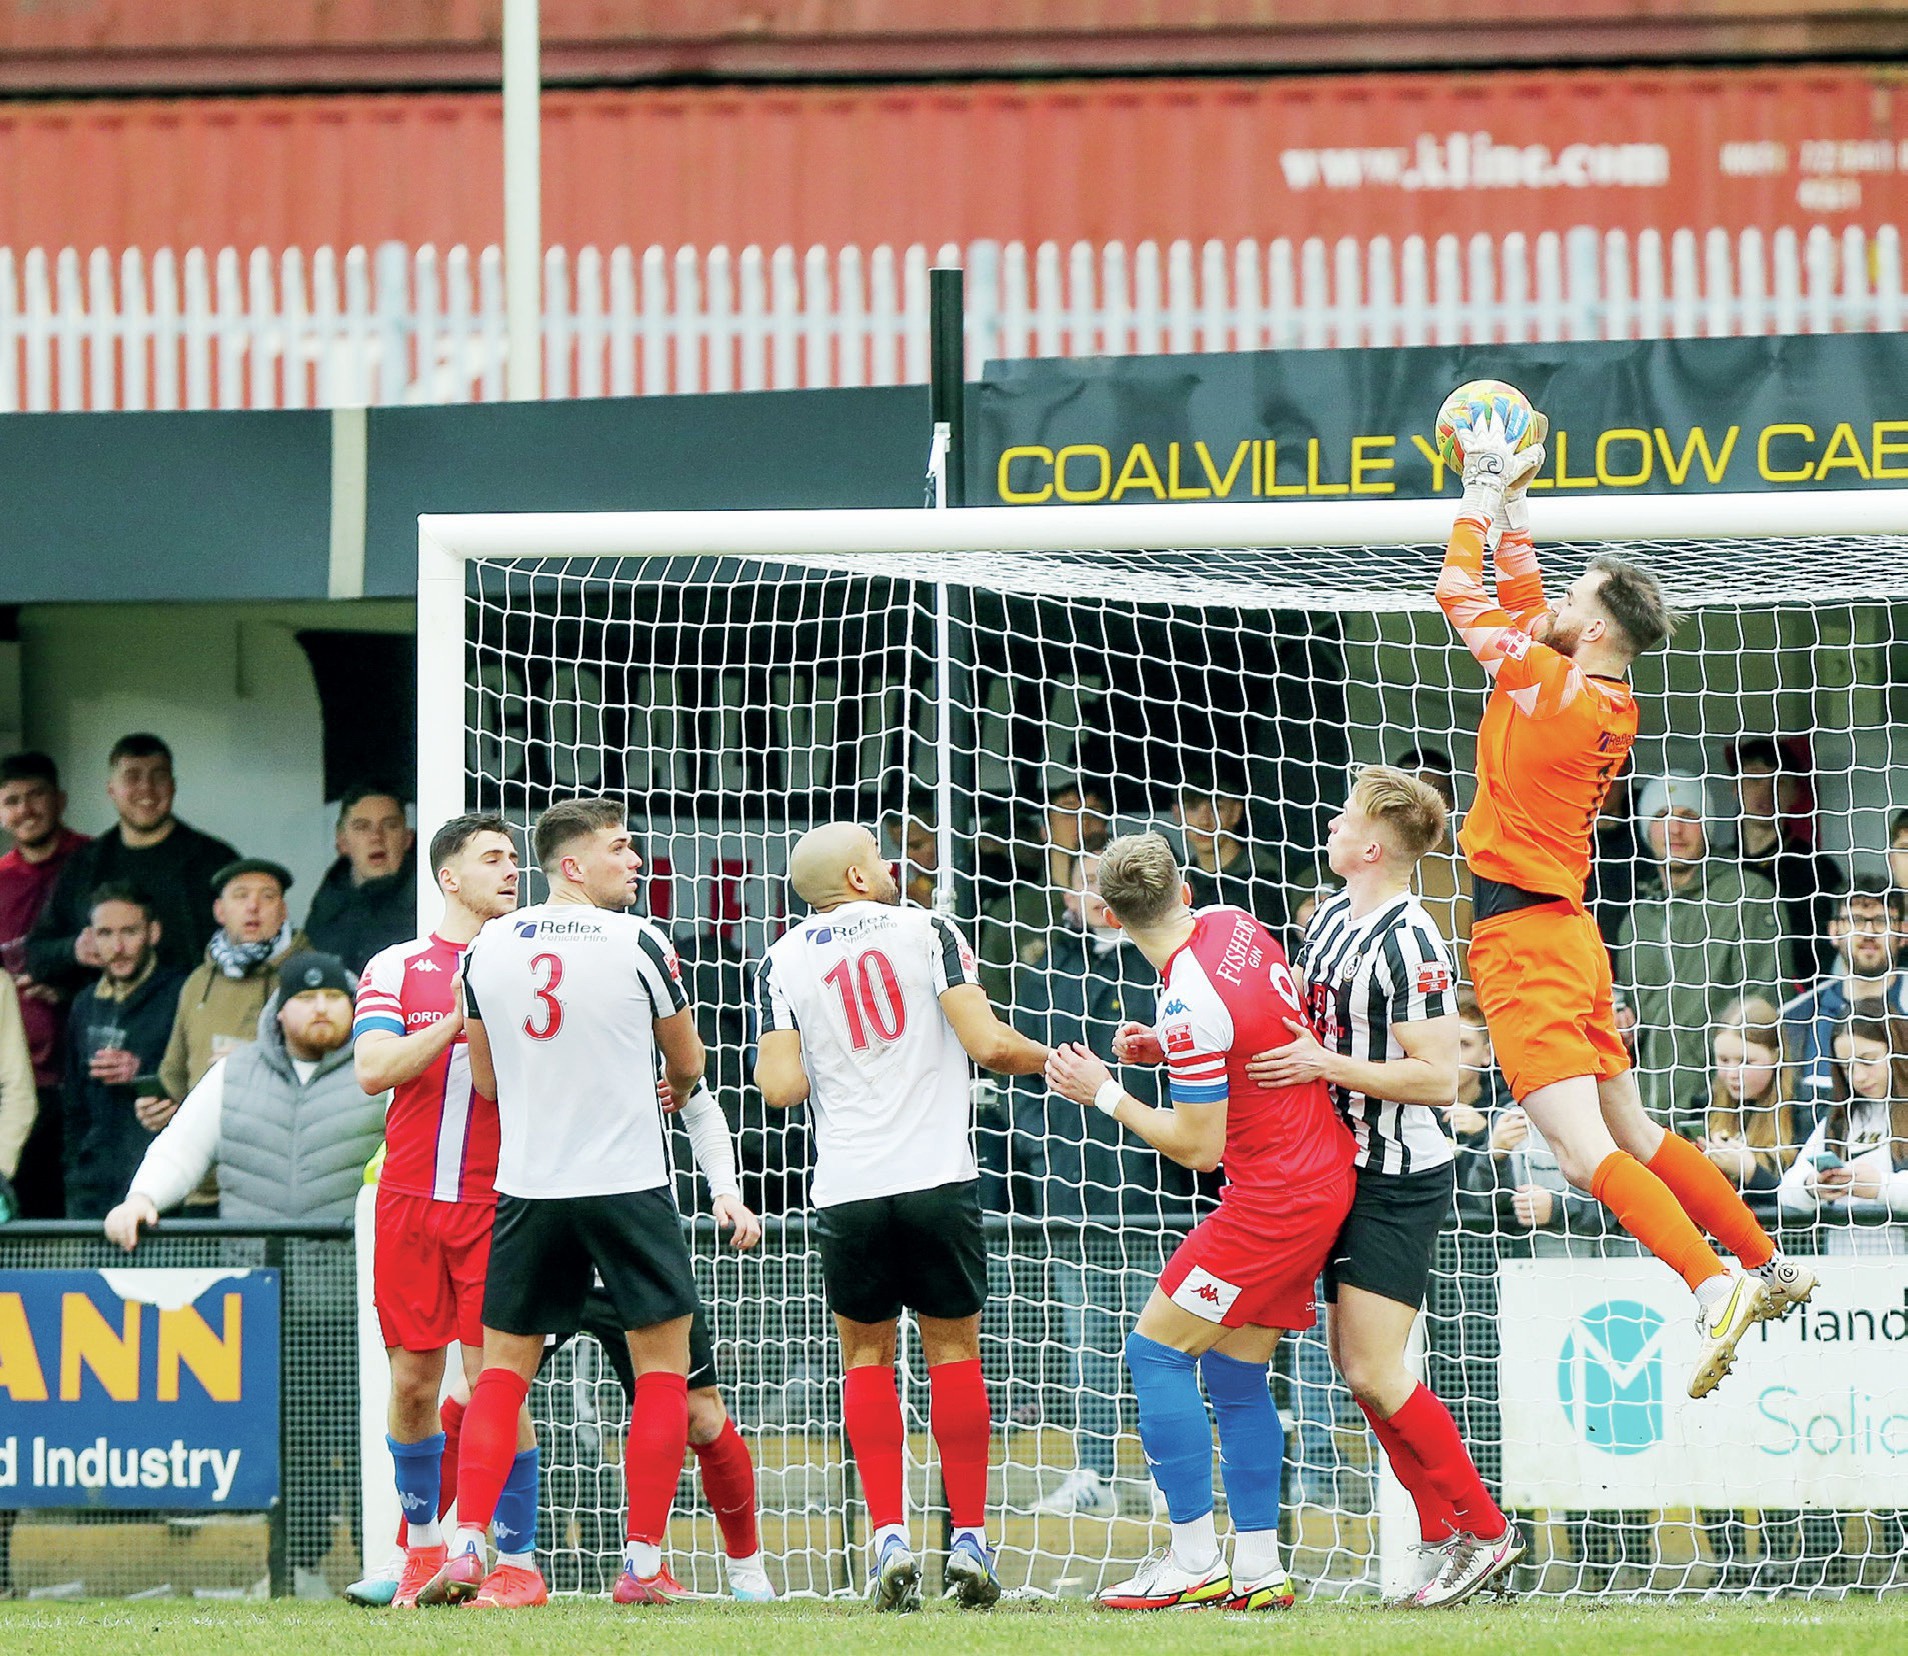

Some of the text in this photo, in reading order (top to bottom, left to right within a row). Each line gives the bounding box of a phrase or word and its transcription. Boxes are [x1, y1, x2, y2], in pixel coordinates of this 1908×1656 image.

[997, 434, 1397, 504] COALVILLE
[1410, 425, 1742, 493] YLOW
[540, 920, 602, 934] Reflex
[540, 933, 608, 943] Vehicle Hire
[833, 913, 890, 937] Reflex
[1247, 945, 1264, 969] GIN
[406, 1010, 452, 1025] JORD
[521, 950, 566, 1042] 3
[821, 947, 907, 1053] 10
[1758, 1385, 1908, 1456] Solic
[33, 1436, 242, 1502] Industry
